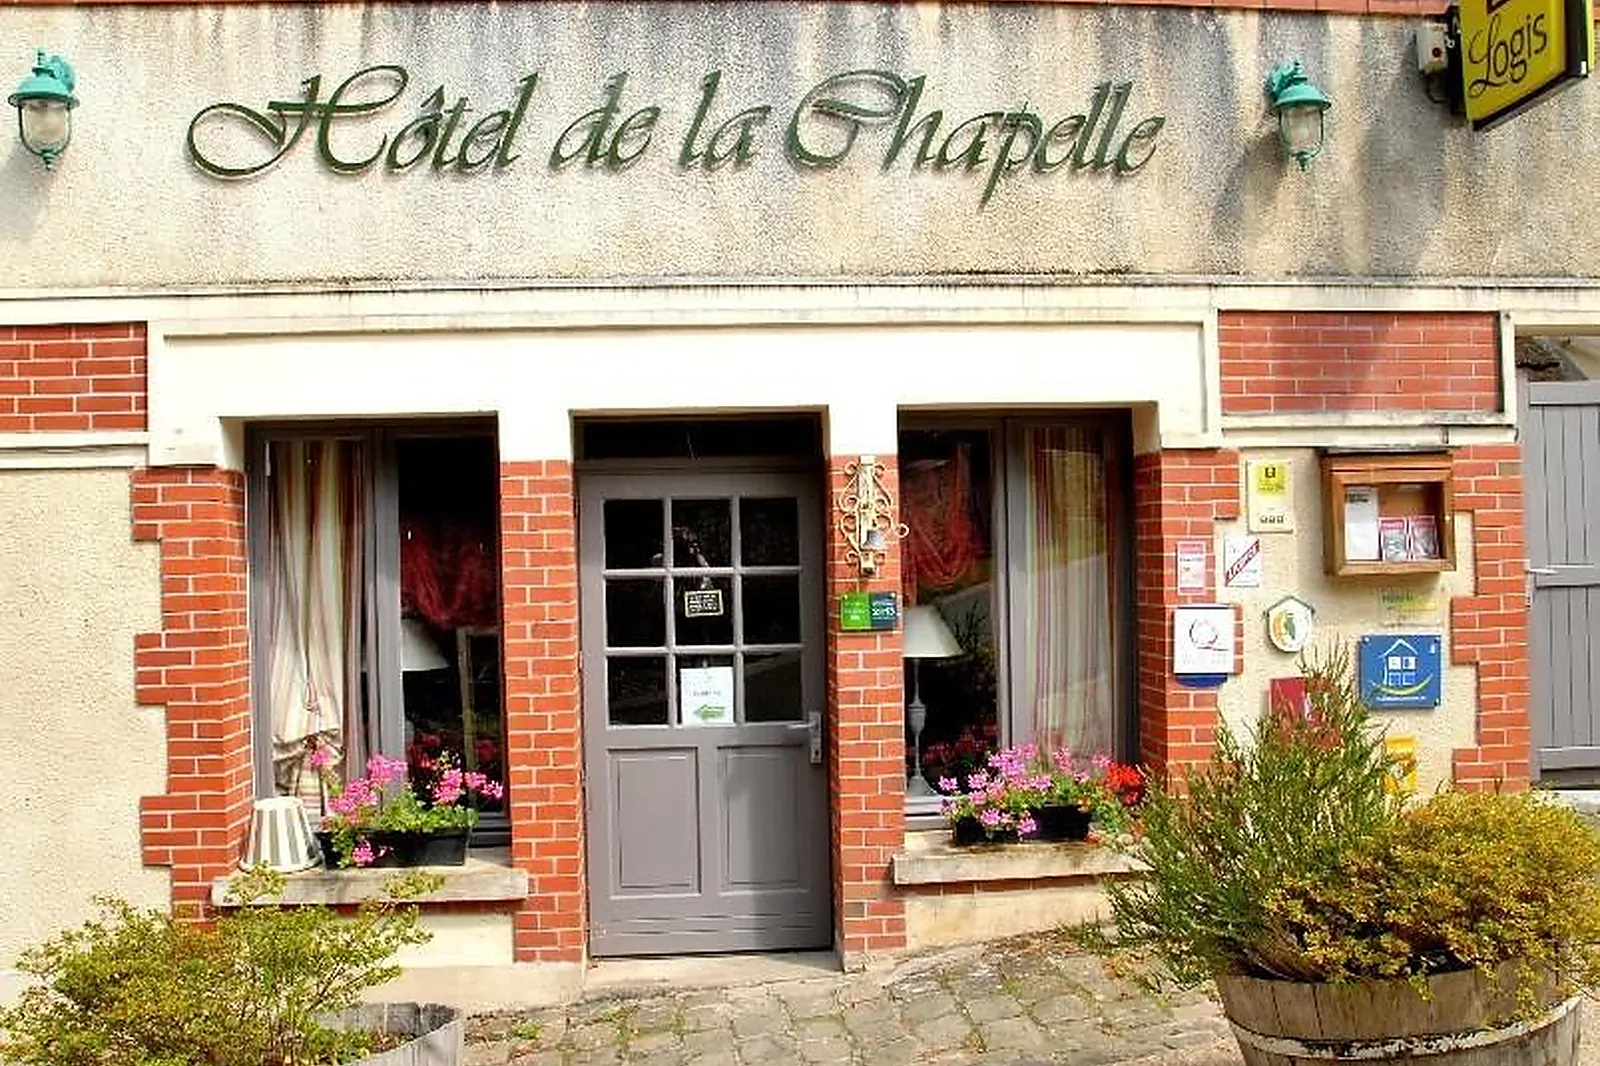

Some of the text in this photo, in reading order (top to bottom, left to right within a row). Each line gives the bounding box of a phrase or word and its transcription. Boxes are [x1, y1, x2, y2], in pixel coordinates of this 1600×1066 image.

[1468, 13, 1547, 98] Logis
[188, 65, 1166, 210] Hôtel de la Chapelle
